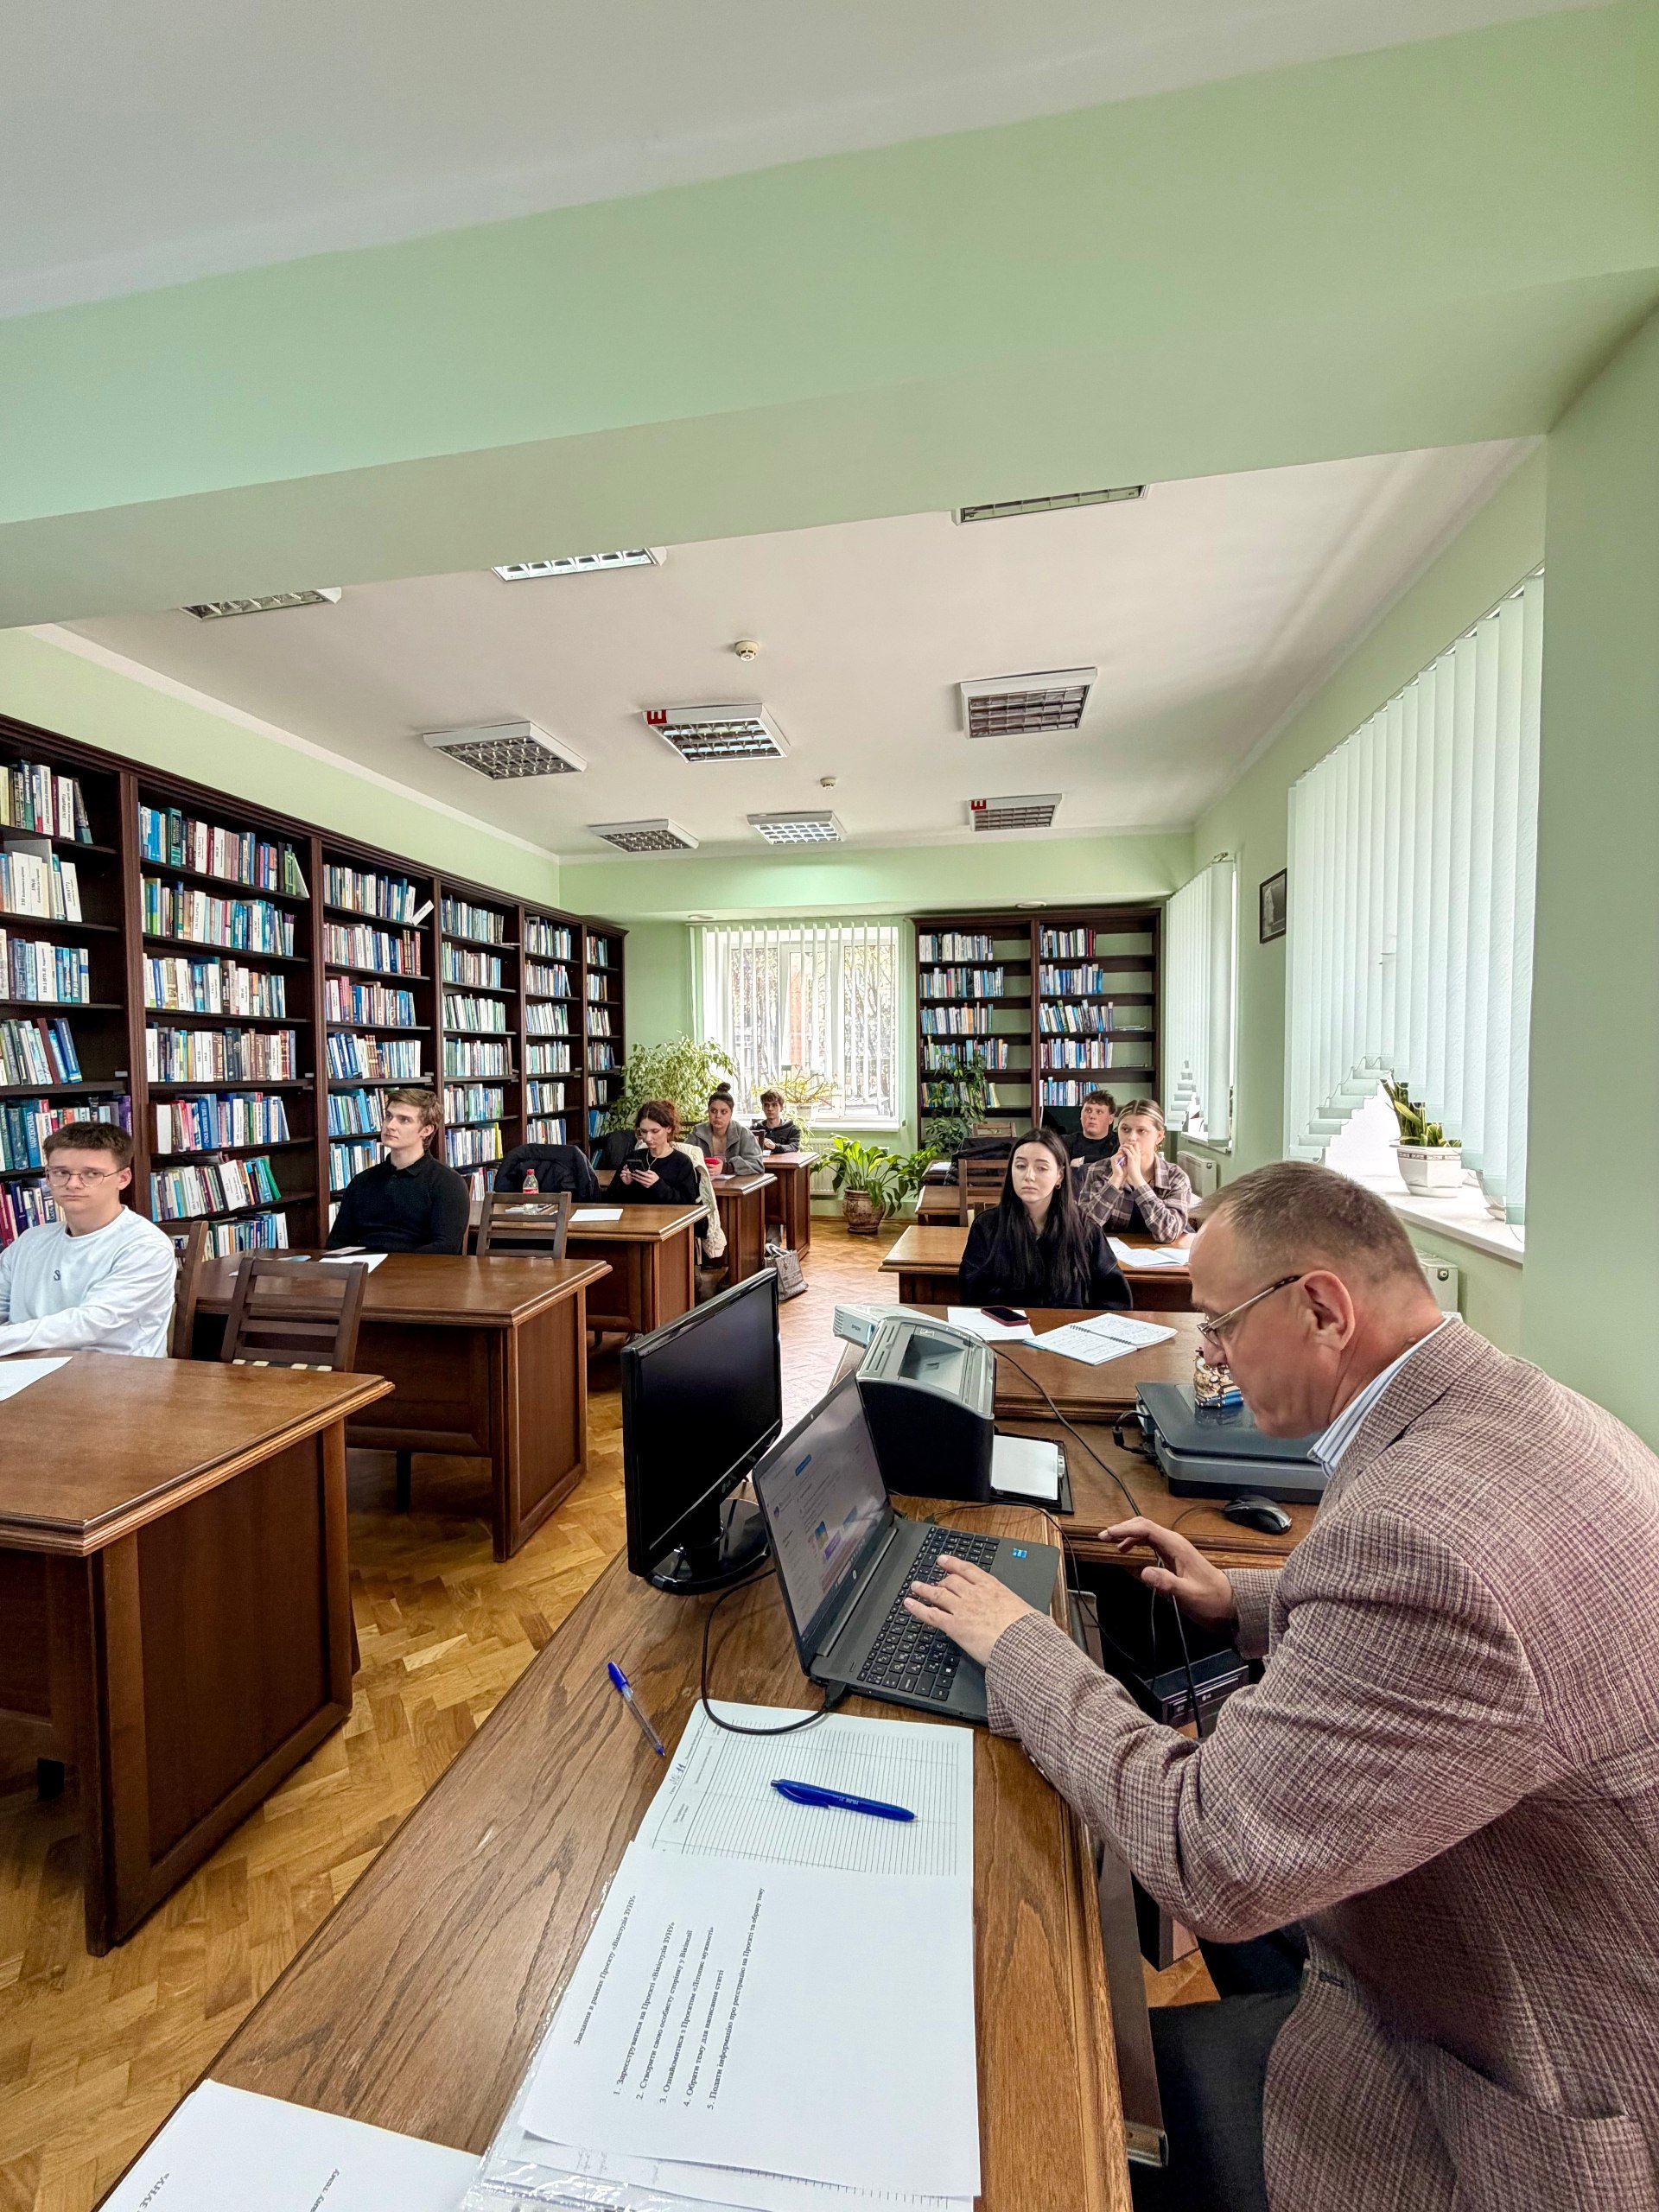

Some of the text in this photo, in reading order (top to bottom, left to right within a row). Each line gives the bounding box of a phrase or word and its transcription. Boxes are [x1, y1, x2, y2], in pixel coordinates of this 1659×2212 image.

[756, 1887, 766, 1902] тему
[749, 1923, 756, 1932] та
[742, 1931, 754, 1958] Проєкті
[741, 1957, 748, 1967] на
[590, 1979, 605, 2006] рамках
[599, 1950, 616, 1980] Проєкту
[670, 1963, 684, 1995] сторінку
[732, 1967, 747, 2007] реєстрацію
[640, 1982, 656, 2011] Проєкті
[639, 2010, 647, 2021] на
[659, 1994, 677, 2029] особисту
[678, 1993, 699, 2031] Проєктом
[725, 2006, 738, 2021] про
[651, 2028, 664, 2050] свою
[683, 1969, 725, 2107] 4. Обрати тему для написання статті
[715, 2021, 734, 2068] інформацію
[615, 2021, 644, 2086] Зареєструватися
[662, 2034, 685, 2094] Ознайомитися
[639, 2048, 658, 2089] Створити
[635, 2091, 645, 2101] 2.
[658, 2094, 668, 2105] 3.
[706, 2101, 715, 2111] 5.
[321, 2168, 340, 2192] тему
